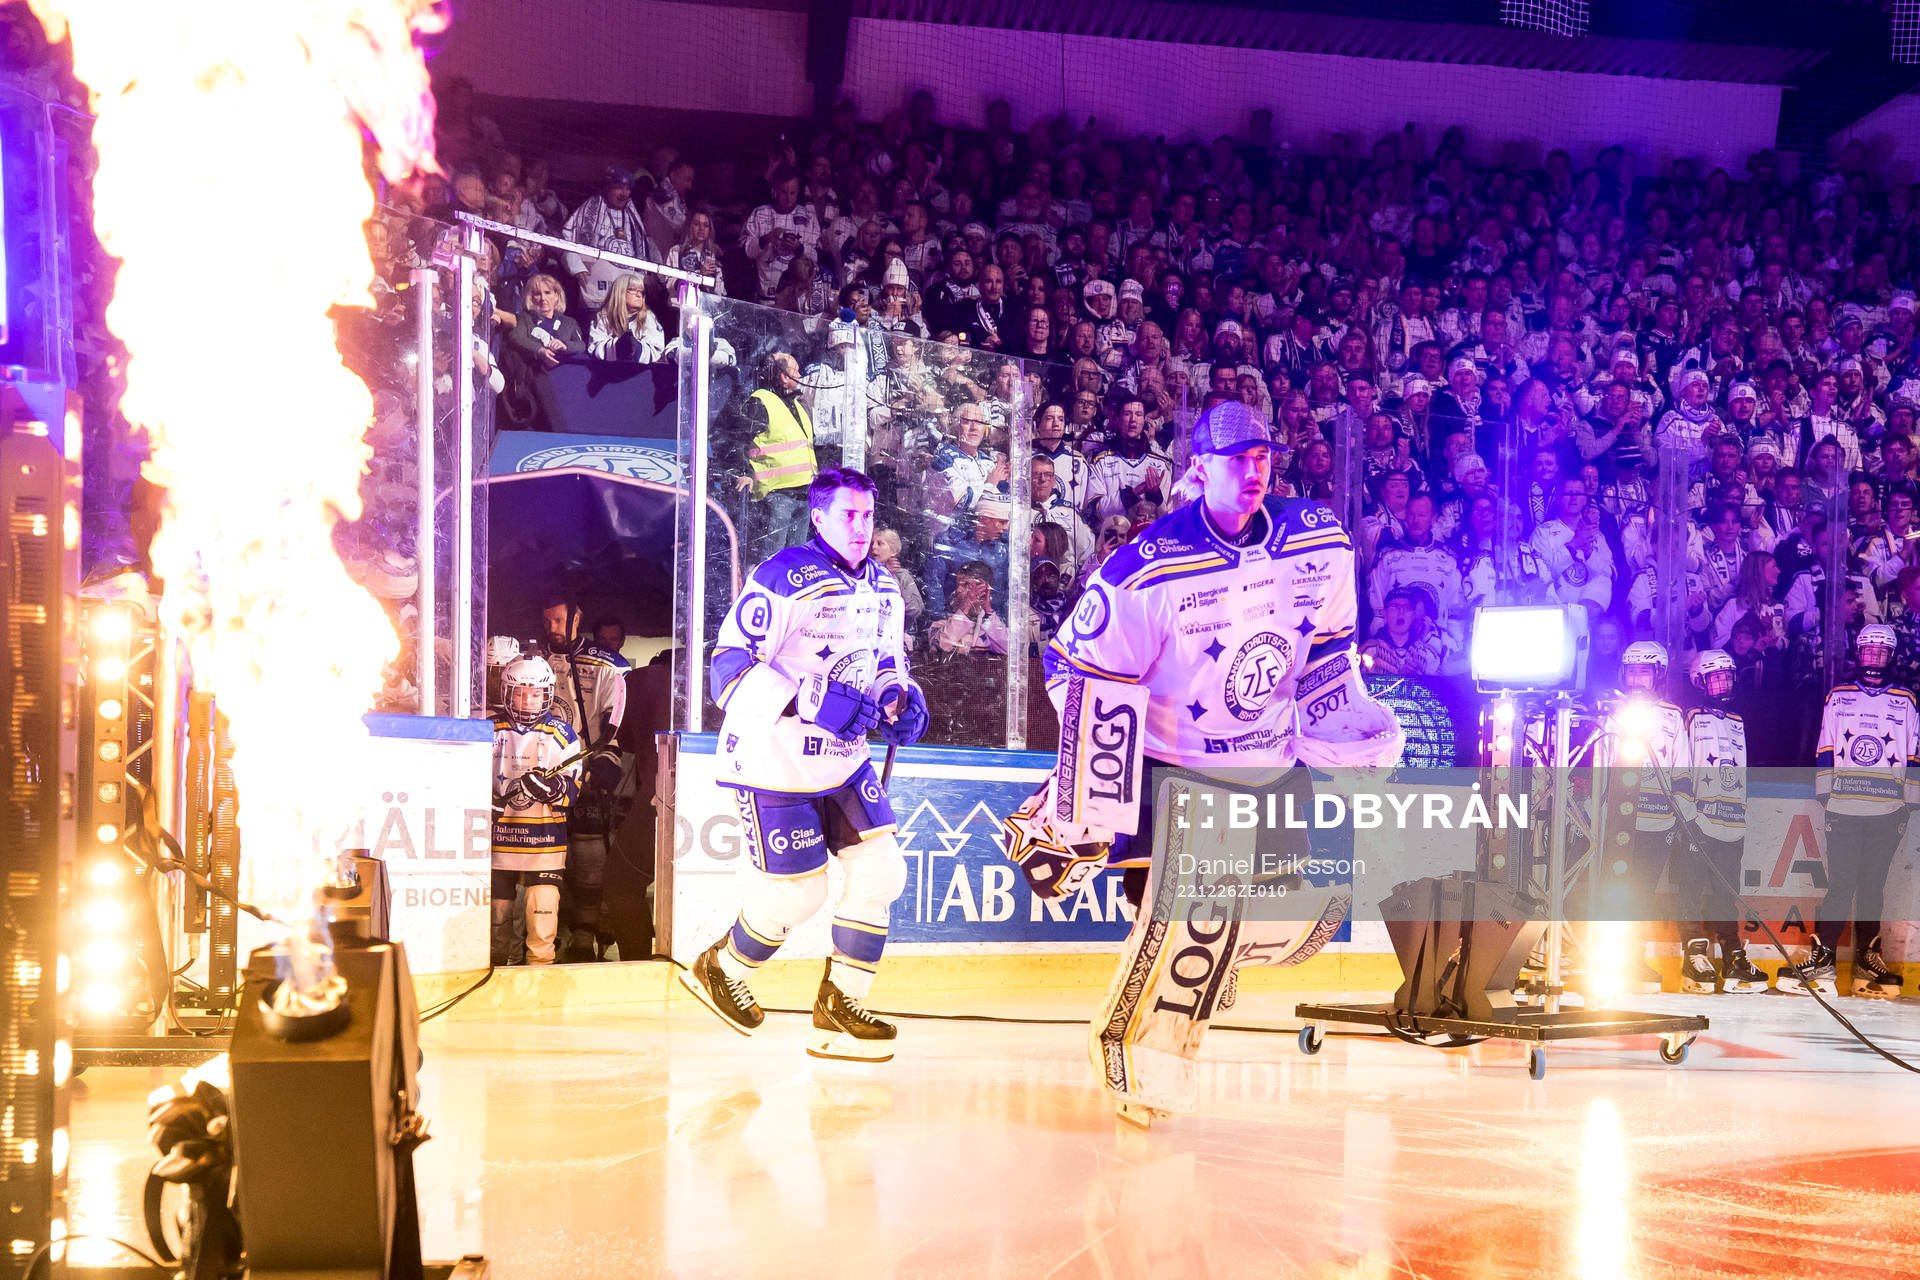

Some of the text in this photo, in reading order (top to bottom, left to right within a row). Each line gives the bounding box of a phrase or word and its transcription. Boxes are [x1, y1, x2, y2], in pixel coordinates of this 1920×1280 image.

[1157, 537, 1179, 547] Clas
[1160, 542, 1194, 554] Ohlson
[800, 564, 818, 574] Clas
[804, 570, 829, 581] Ohlson
[1249, 578, 1275, 591] TEGERA
[1198, 586, 1229, 598] Bergkvist
[1200, 598, 1218, 607] Siljan
[751, 606, 766, 628] 8
[1079, 598, 1097, 627] 31
[1195, 626, 1212, 634] KARL
[1306, 684, 1350, 727] LOGS
[1060, 713, 1079, 781] BAUER
[1090, 697, 1137, 804] LOGS
[790, 828, 815, 841] Clas
[791, 834, 824, 851] Ohlson
[937, 864, 1016, 922] AB
